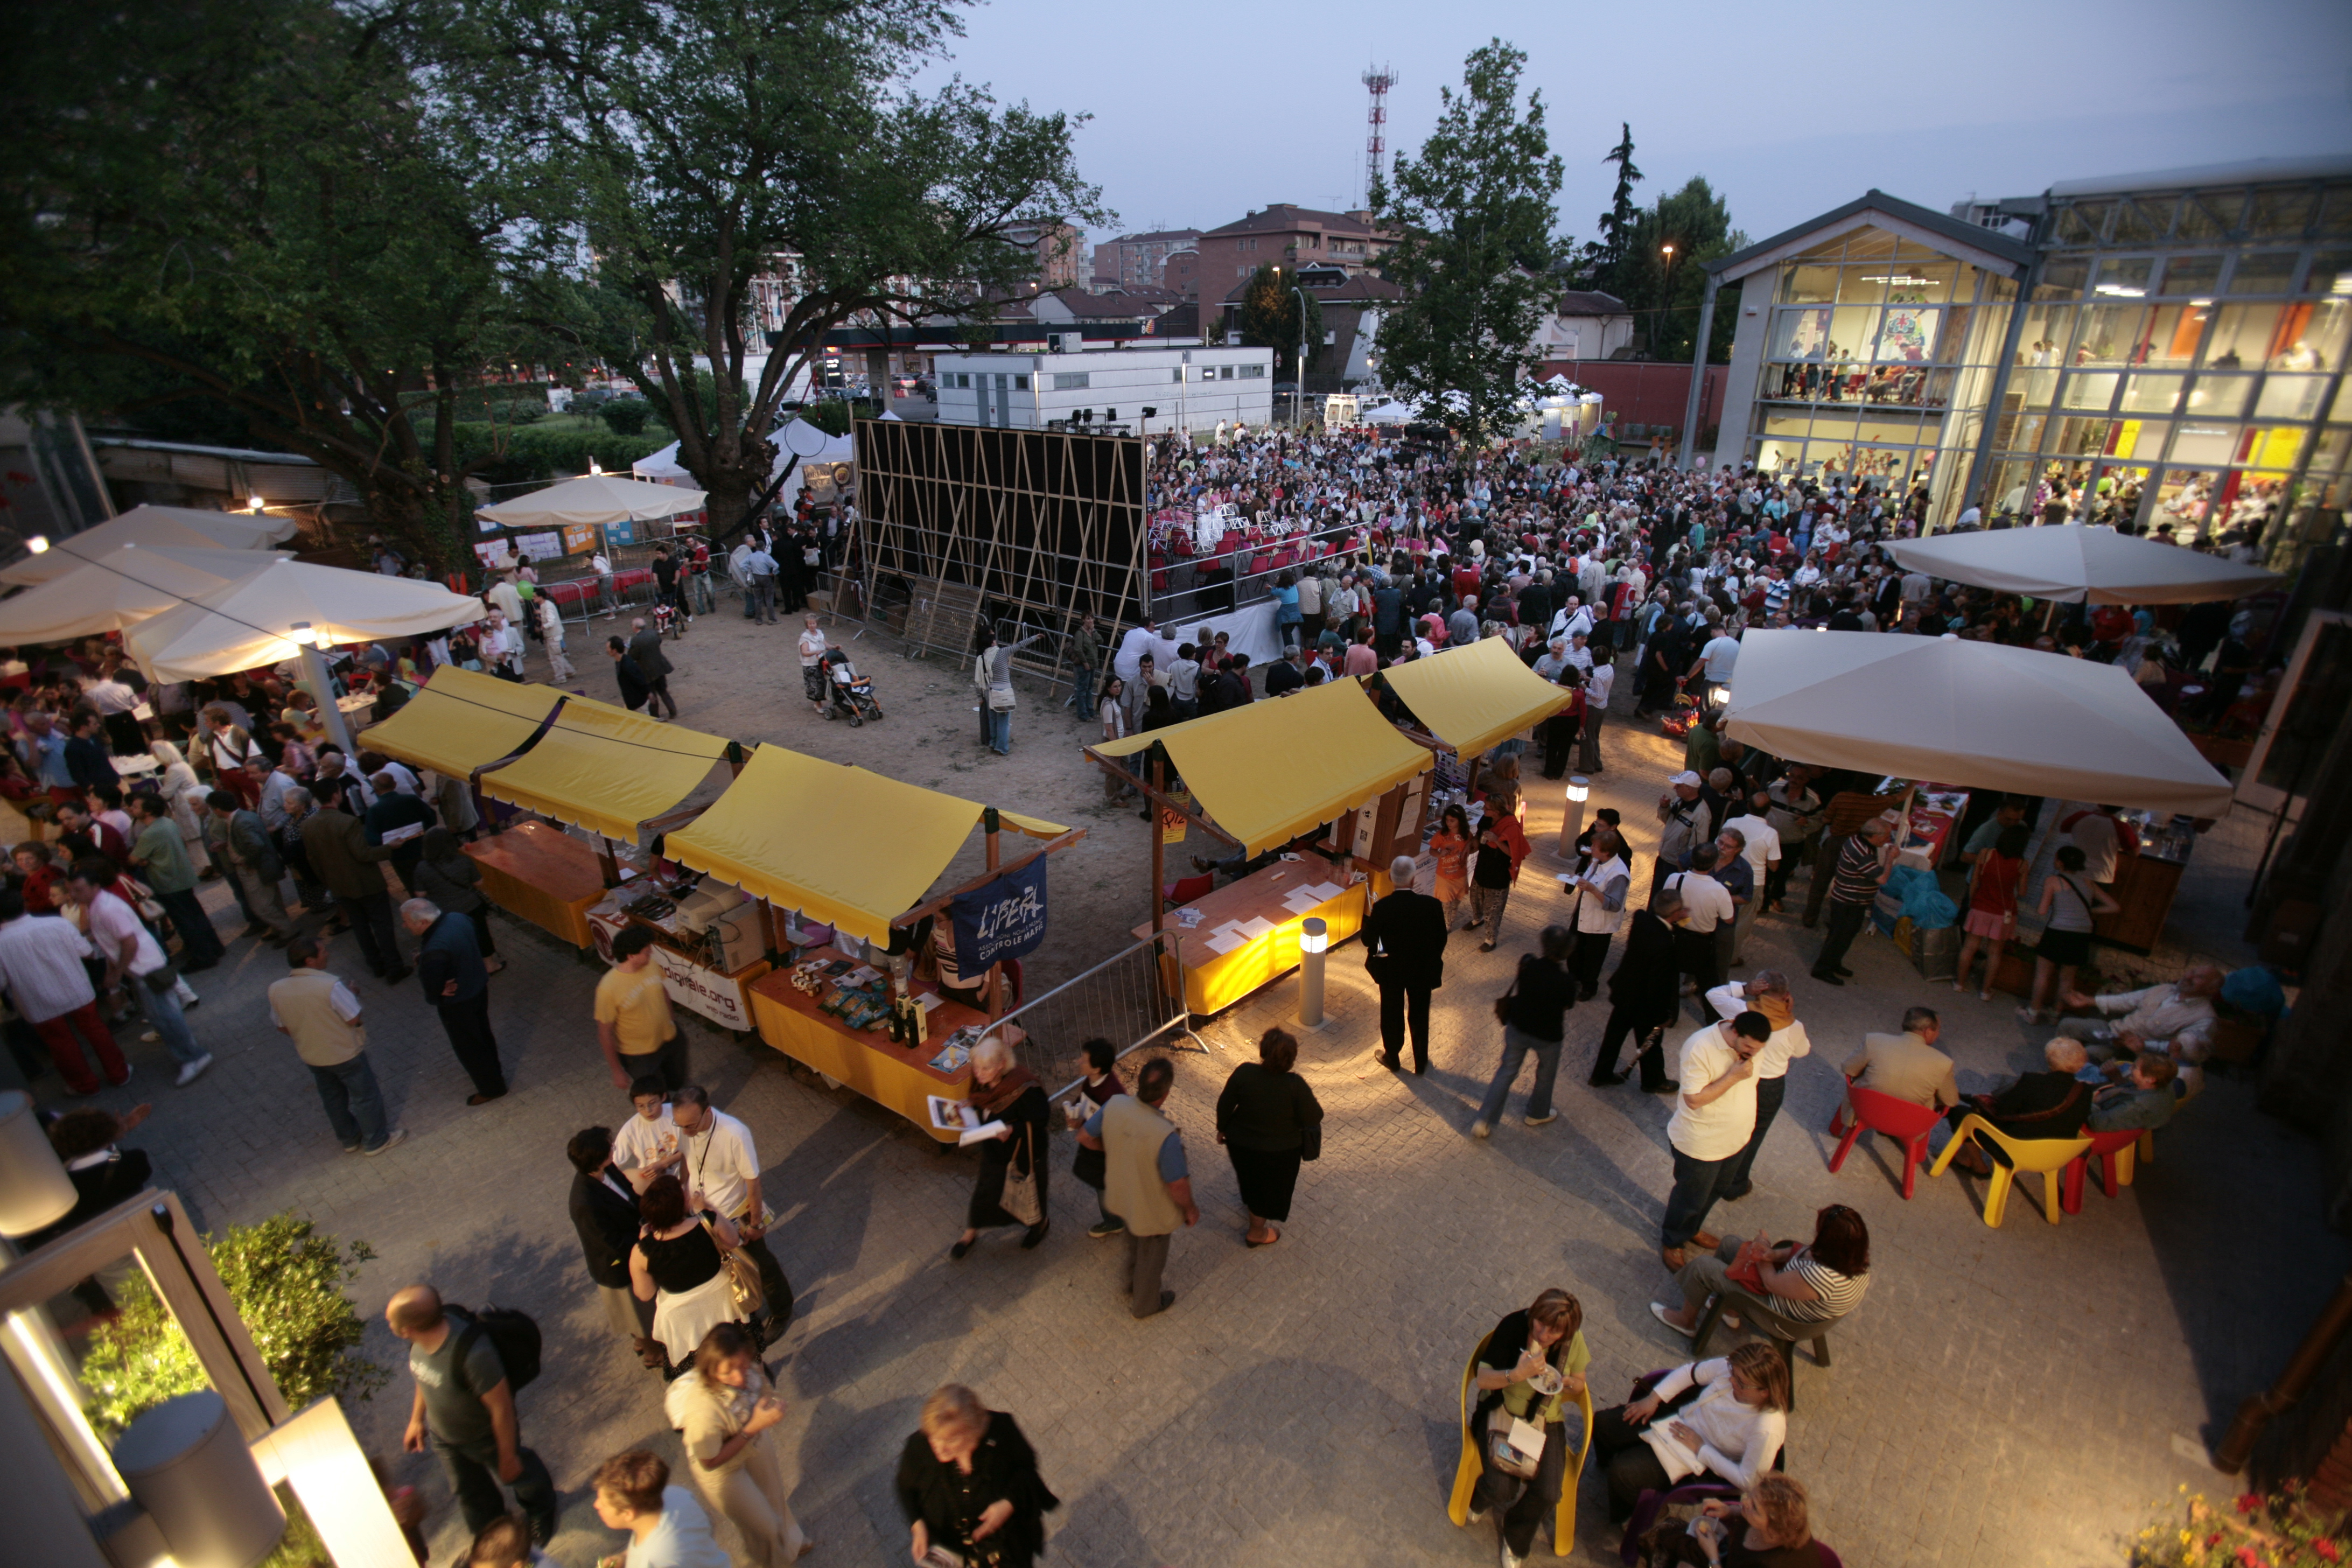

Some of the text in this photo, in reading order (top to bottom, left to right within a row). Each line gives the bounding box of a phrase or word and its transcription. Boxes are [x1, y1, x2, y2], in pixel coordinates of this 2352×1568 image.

[977, 883, 1044, 939] LIBERA
[978, 934, 1011, 951] ASSOCZIONI
[980, 921, 1044, 960] CONTRO LE MAFIE
[661, 965, 736, 1012] digitale.org
[719, 1011, 739, 1021] radio
